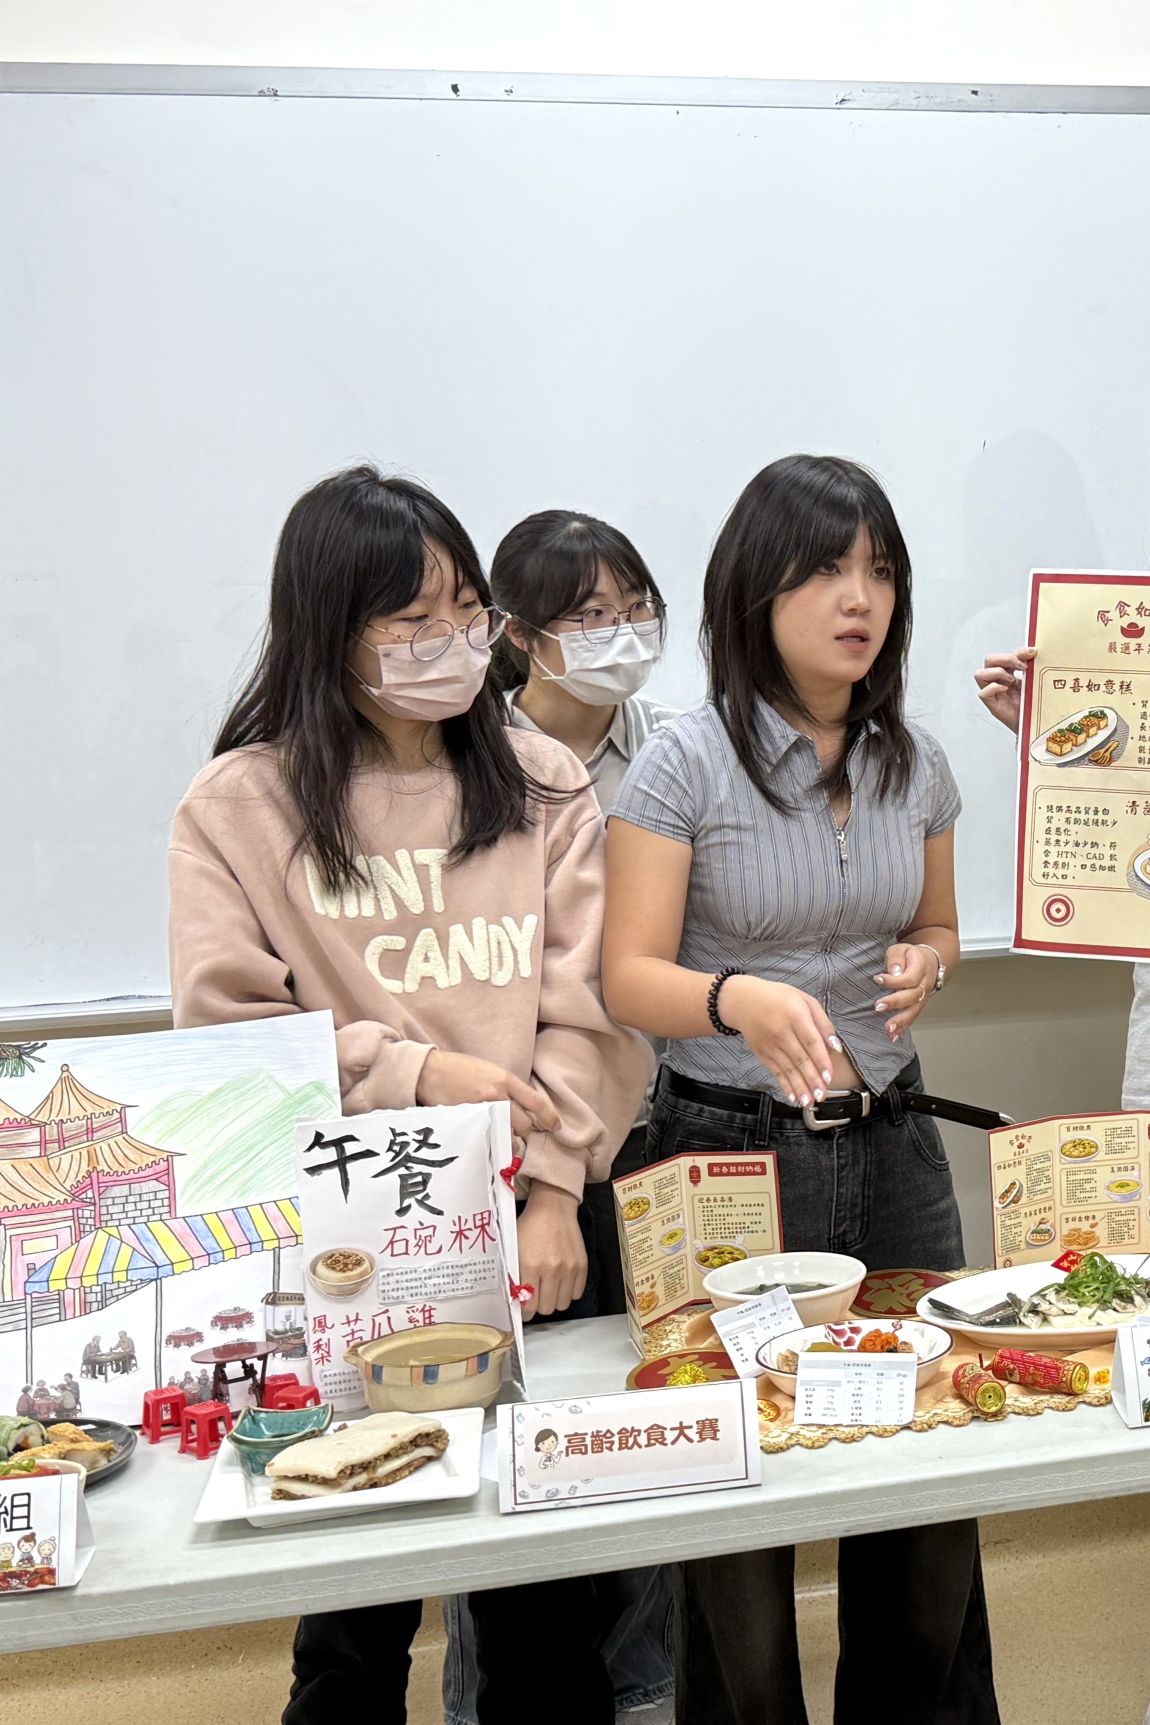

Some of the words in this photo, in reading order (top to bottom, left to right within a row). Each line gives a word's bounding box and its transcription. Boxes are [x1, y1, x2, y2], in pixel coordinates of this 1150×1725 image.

[1053, 678, 1133, 695] 四喜如意糕
[364, 913, 538, 994] CANDY
[303, 1126, 460, 1218] 午餐
[311, 1313, 335, 1367] 鳳梨
[563, 1417, 721, 1457] 高齡飲食大賽
